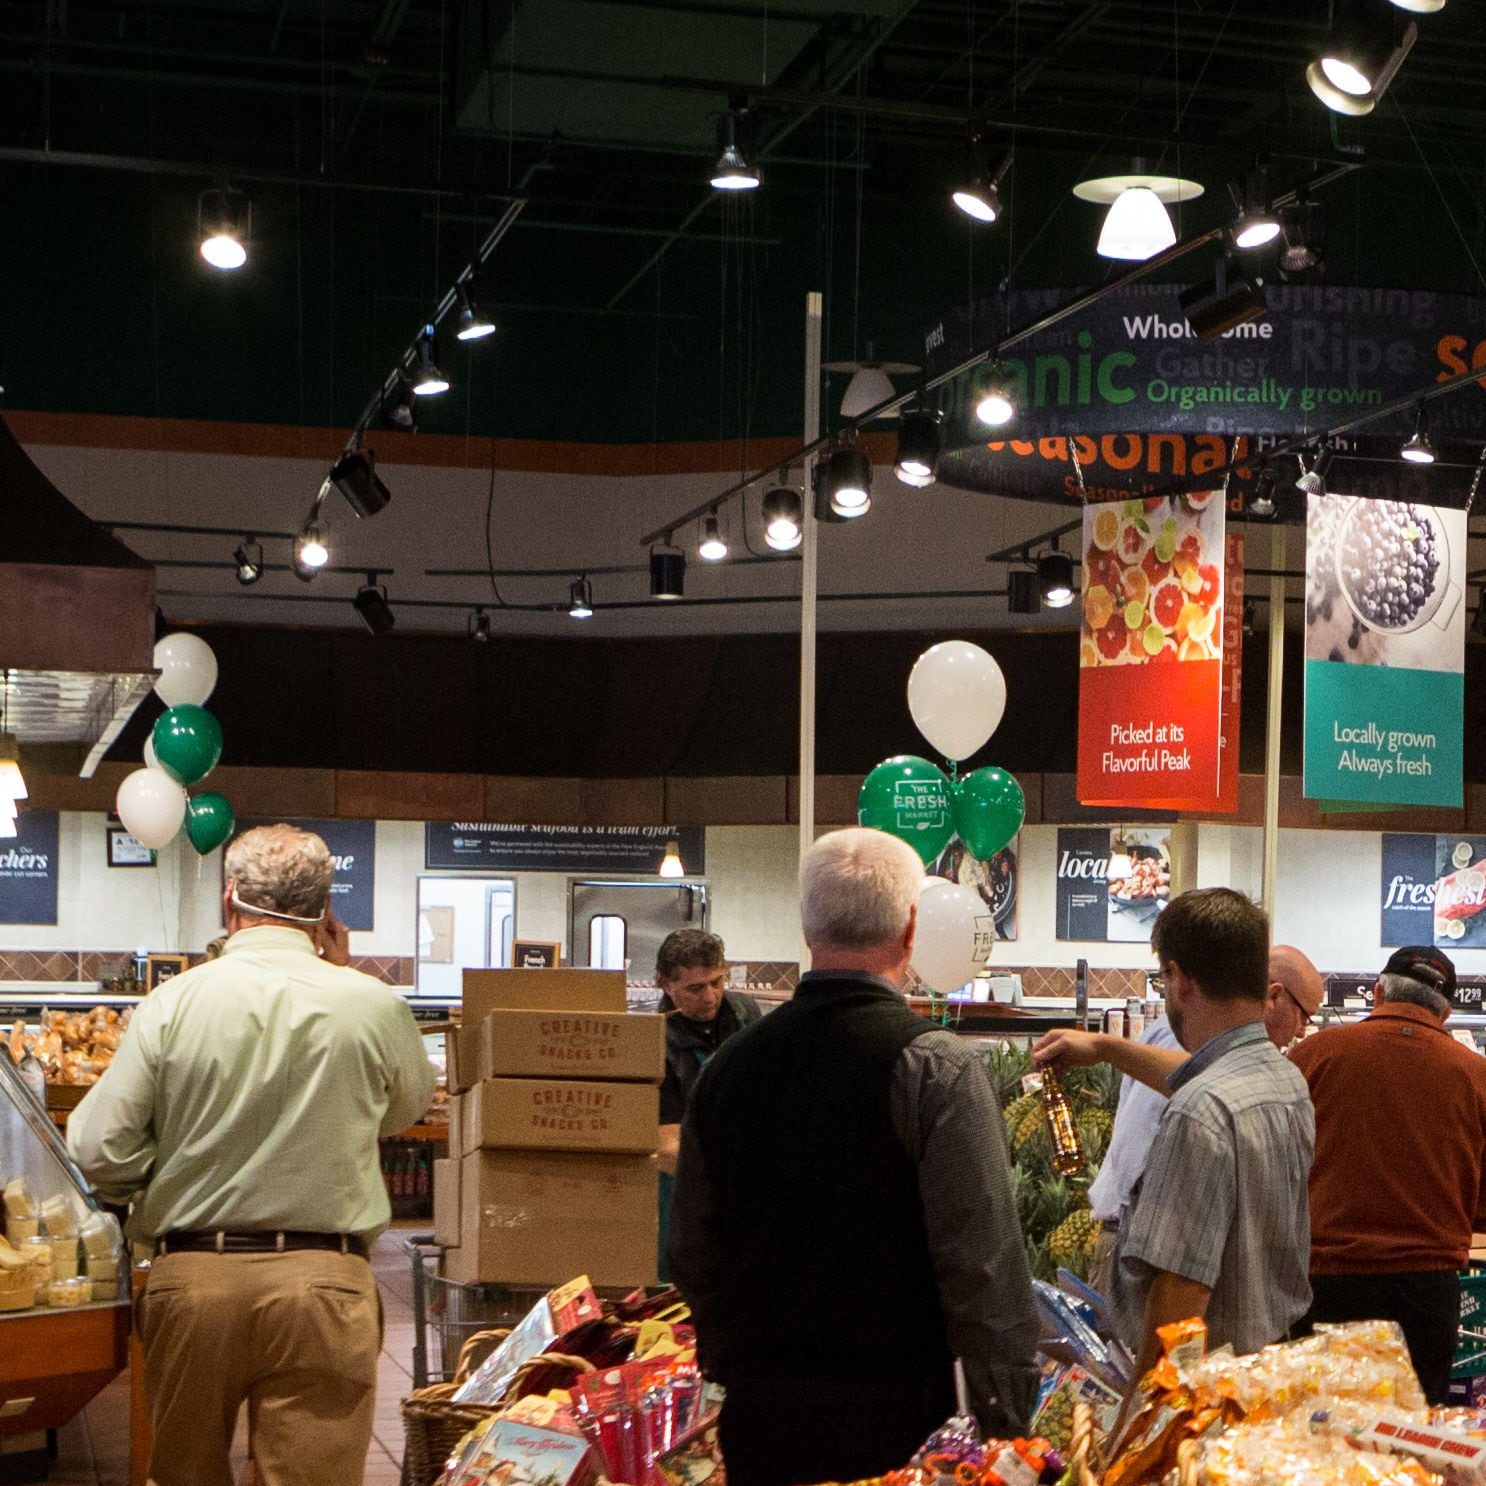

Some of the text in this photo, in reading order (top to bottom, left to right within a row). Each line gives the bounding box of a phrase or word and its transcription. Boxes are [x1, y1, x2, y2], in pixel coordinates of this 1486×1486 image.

[1123, 314, 1273, 340] Wholome
[1147, 379, 1383, 412] Organically grown
[1111, 723, 1184, 745] Picked at its
[1334, 721, 1436, 751] Locally grown
[1102, 749, 1191, 774] Flavorful Peak
[1338, 754, 1432, 779] Always fresh
[912, 785, 929, 794] THE
[894, 795, 947, 809] FRESH
[0, 849, 48, 870] chers
[1058, 850, 1114, 879] loca
[1384, 875, 1486, 910] freshest
[974, 930, 995, 946] FRE
[539, 1019, 620, 1037] CREATIVE
[532, 1089, 613, 1108] CREATIVE
